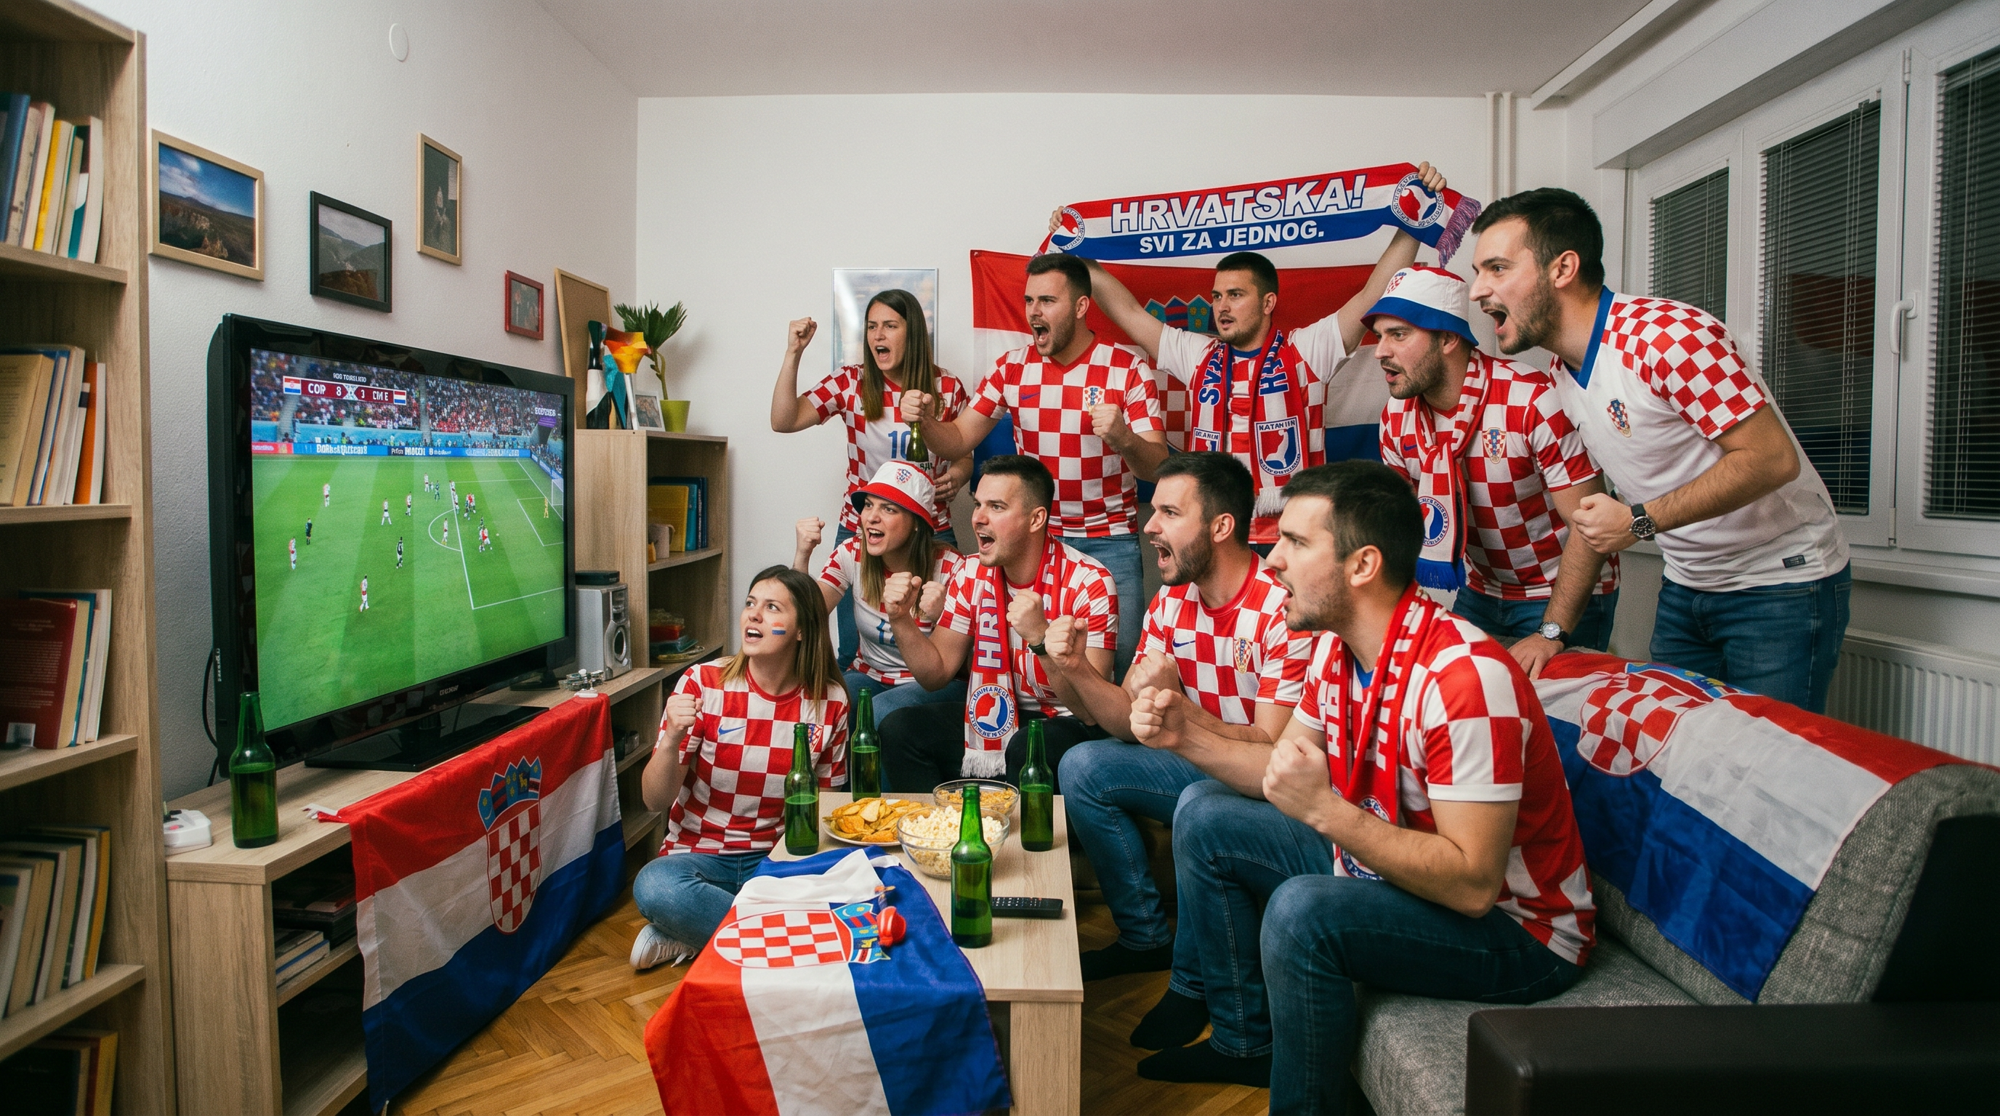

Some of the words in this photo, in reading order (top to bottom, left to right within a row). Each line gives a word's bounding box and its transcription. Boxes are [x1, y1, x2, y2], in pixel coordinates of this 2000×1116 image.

[1111, 174, 1367, 233] HRVATSKA!
[1139, 234, 1174, 253] SVI
[1181, 231, 1213, 250] ZA
[1219, 220, 1325, 248] JEDNOG.
[888, 430, 912, 459] 10
